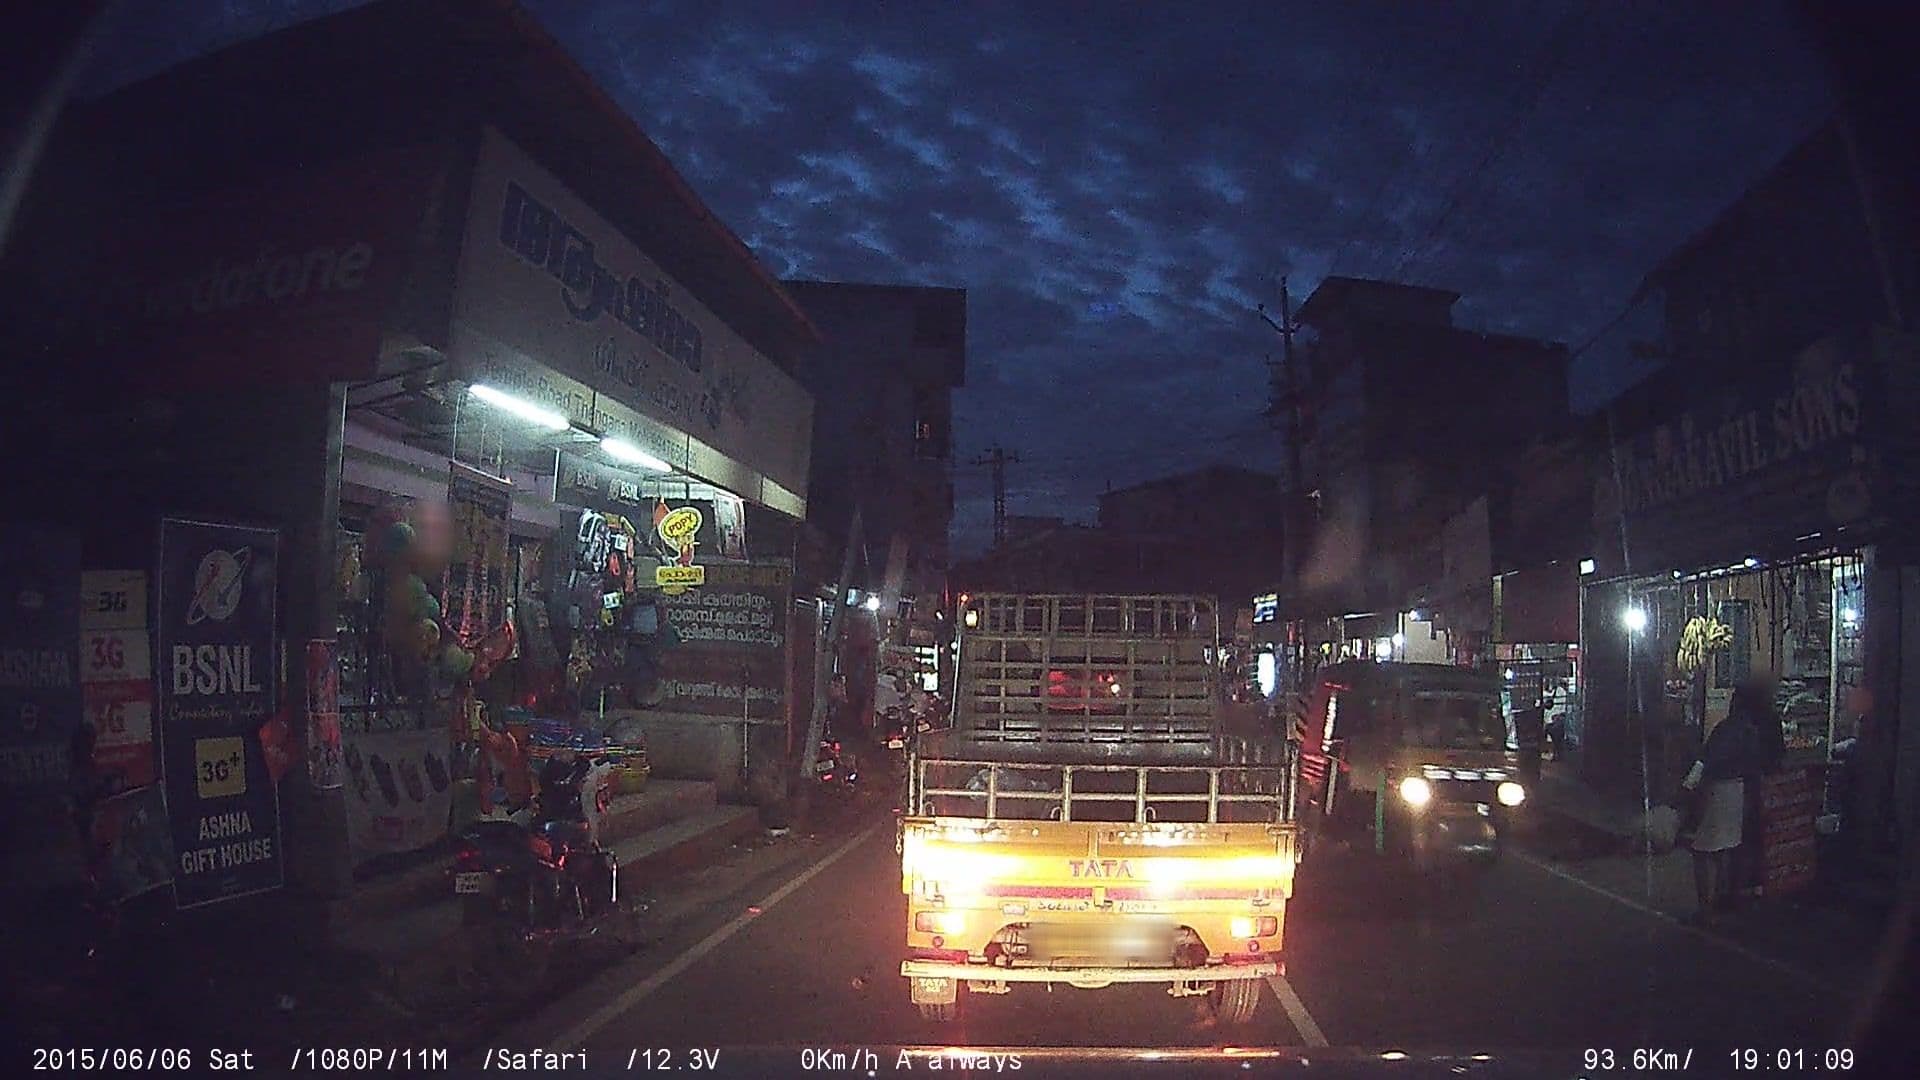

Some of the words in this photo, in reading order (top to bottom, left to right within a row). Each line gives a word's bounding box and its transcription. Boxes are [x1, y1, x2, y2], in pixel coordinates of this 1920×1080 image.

[538, 375, 571, 410] Road
[668, 514, 694, 535] POPY
[91, 637, 125, 671] 3G
[173, 644, 261, 695] BSNL
[199, 811, 252, 841] ASHNA
[181, 848, 217, 874] GIFT
[221, 838, 272, 867] HOUSE
[1069, 859, 1134, 878] TATA
